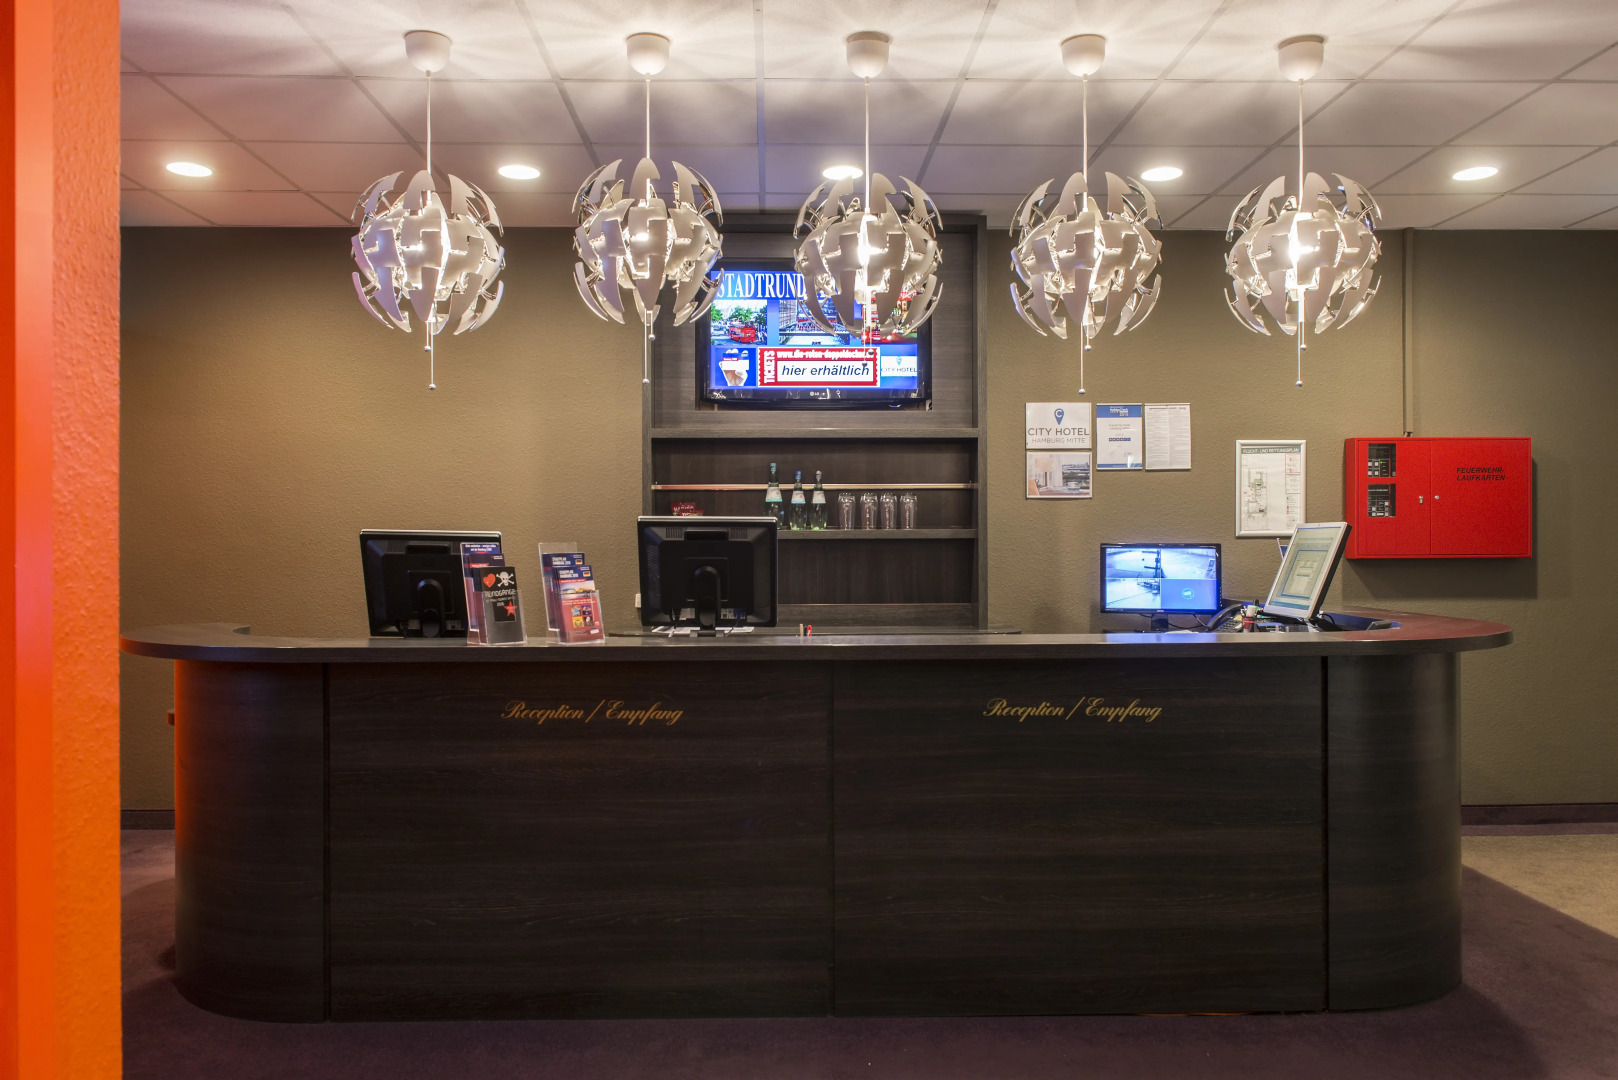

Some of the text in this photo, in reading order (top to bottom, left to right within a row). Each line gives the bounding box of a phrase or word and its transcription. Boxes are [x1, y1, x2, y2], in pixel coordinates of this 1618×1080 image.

[781, 364, 870, 376] hier erhältlich
[1027, 427, 1090, 436] CITY HOTEL
[501, 700, 585, 725] Reception
[605, 700, 684, 726] Empfang
[983, 697, 1066, 723] Reception
[1085, 697, 1163, 723] Empfang
